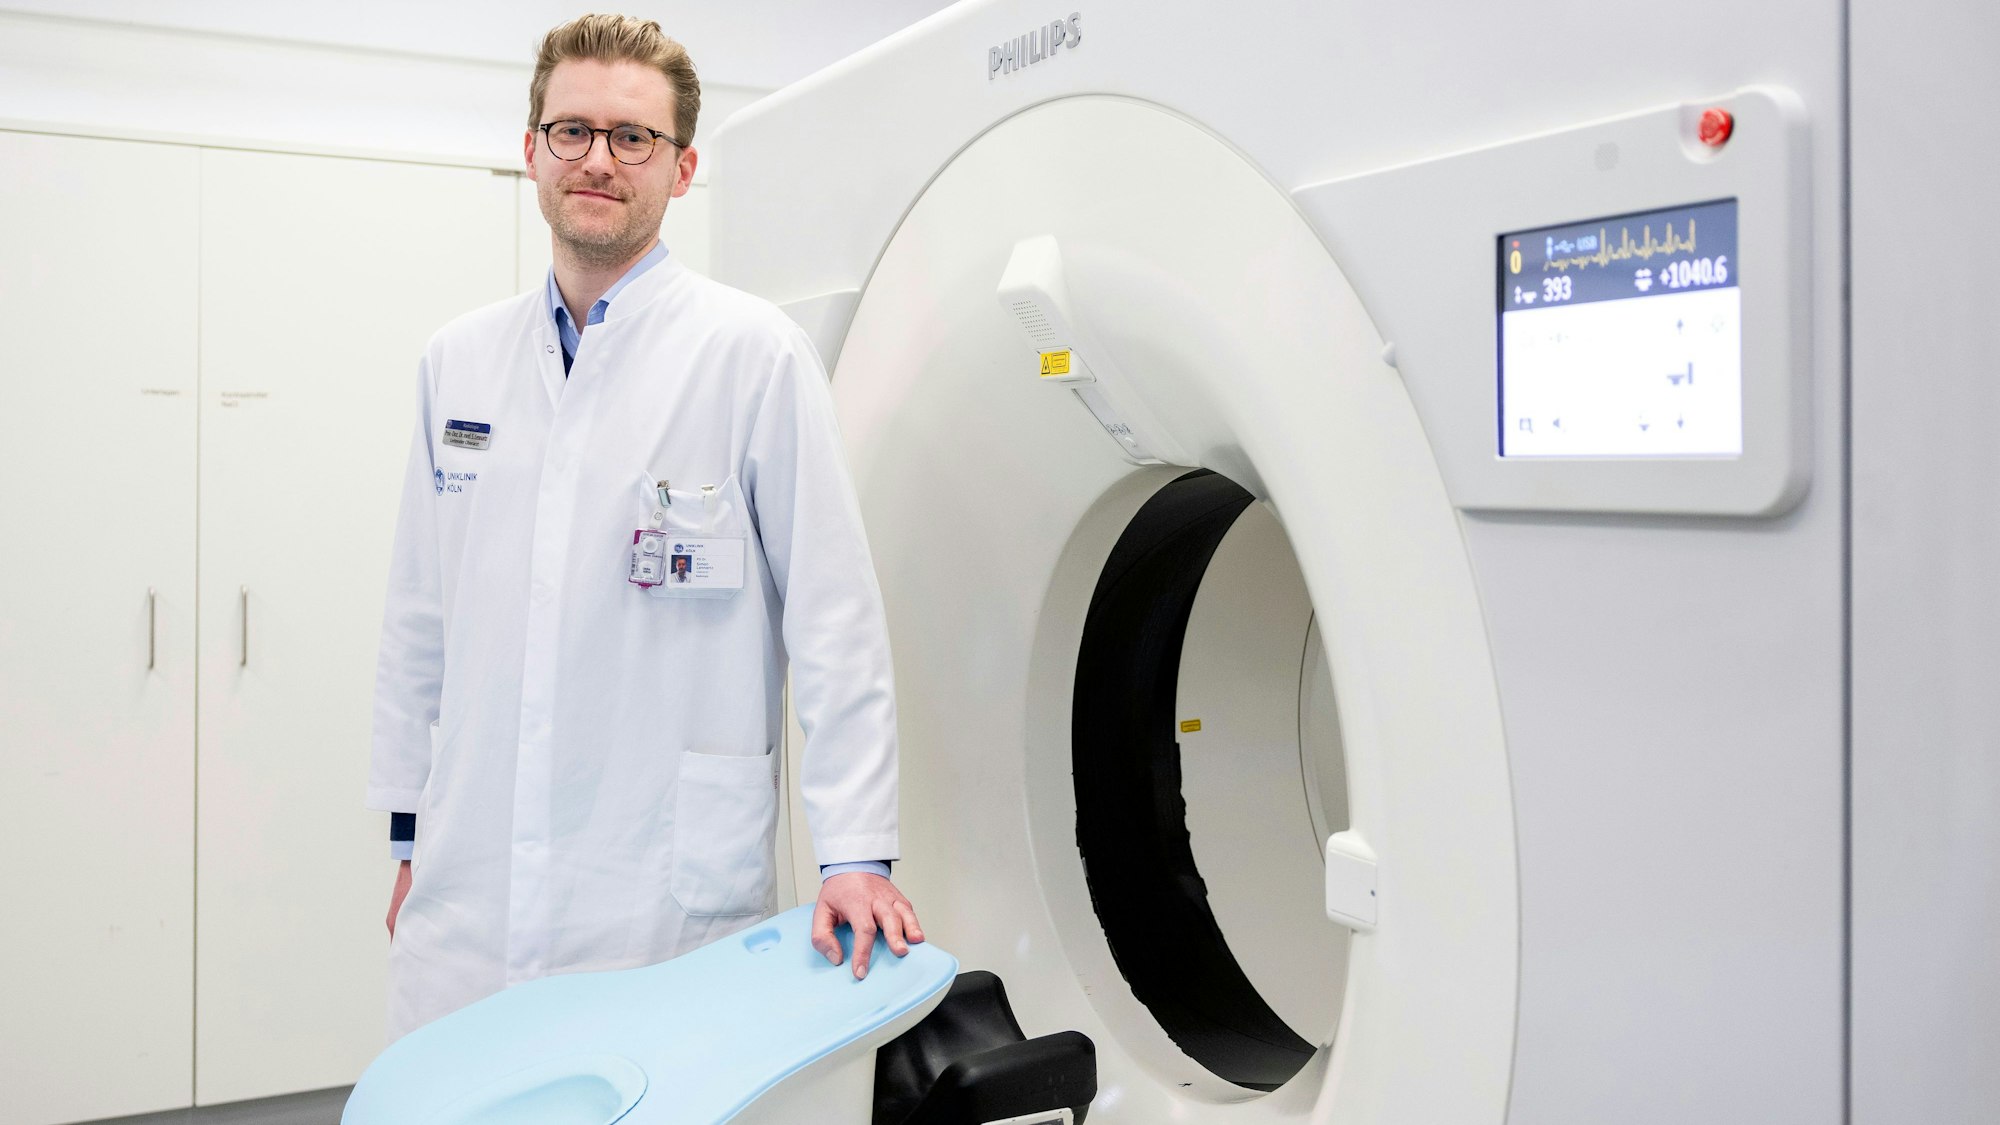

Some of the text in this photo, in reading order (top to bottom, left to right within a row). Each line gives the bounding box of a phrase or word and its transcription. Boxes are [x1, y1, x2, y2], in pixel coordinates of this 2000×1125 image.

[988, 11, 1082, 81] PHILIPS
[1576, 235, 1598, 251] USB
[1659, 255, 1728, 289] +1040.6
[1542, 275, 1573, 303] 393
[447, 472, 478, 481] UNIKLINIK
[447, 484, 462, 493] KÖLN
